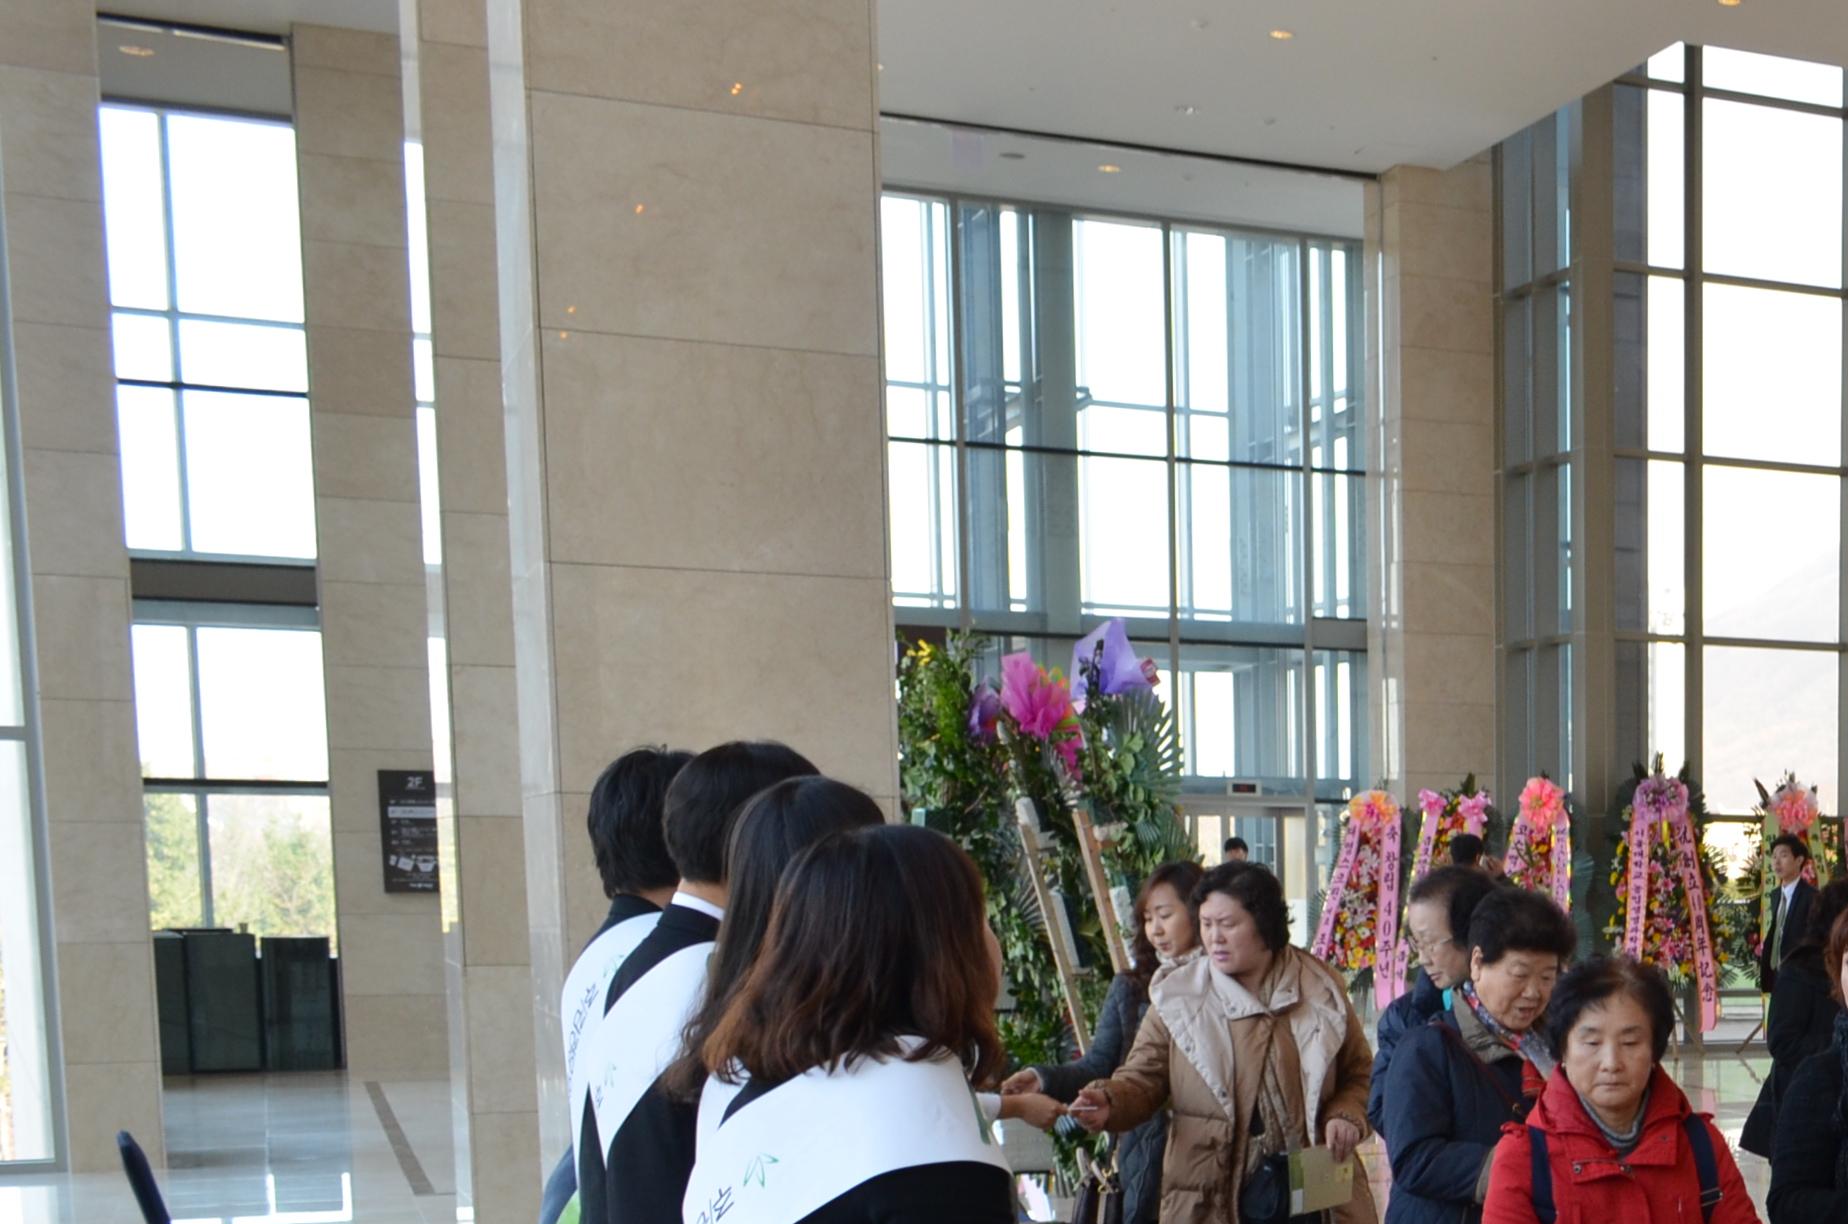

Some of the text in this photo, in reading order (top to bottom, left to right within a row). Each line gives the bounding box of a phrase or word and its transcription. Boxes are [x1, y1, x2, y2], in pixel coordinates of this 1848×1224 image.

[407, 776, 423, 787] 2F
[1384, 852, 1398, 892] 창립
[1378, 900, 1394, 979] 40주년
